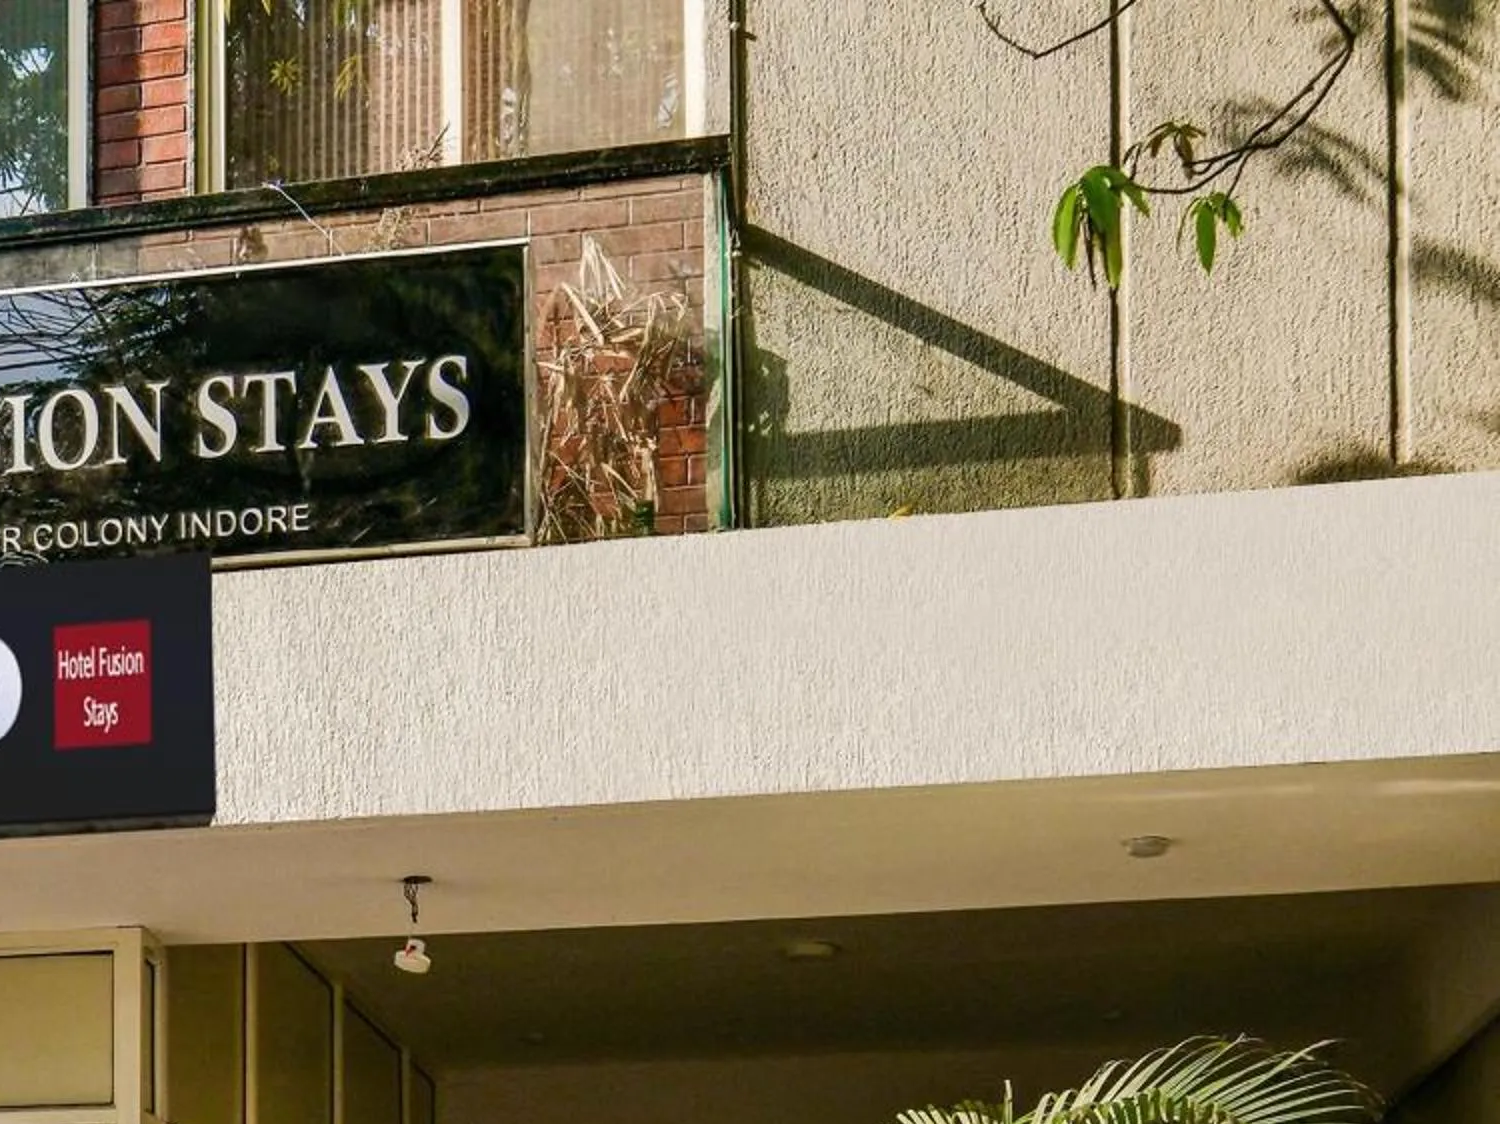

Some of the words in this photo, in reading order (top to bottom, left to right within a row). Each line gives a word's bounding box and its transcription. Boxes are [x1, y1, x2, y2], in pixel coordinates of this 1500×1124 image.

[197, 354, 471, 459] STAYS
[33, 512, 169, 551] COLONY
[180, 504, 311, 539] INDORE
[58, 645, 95, 679] Hotel
[99, 645, 144, 677] Fusion
[83, 696, 119, 733] Stays
